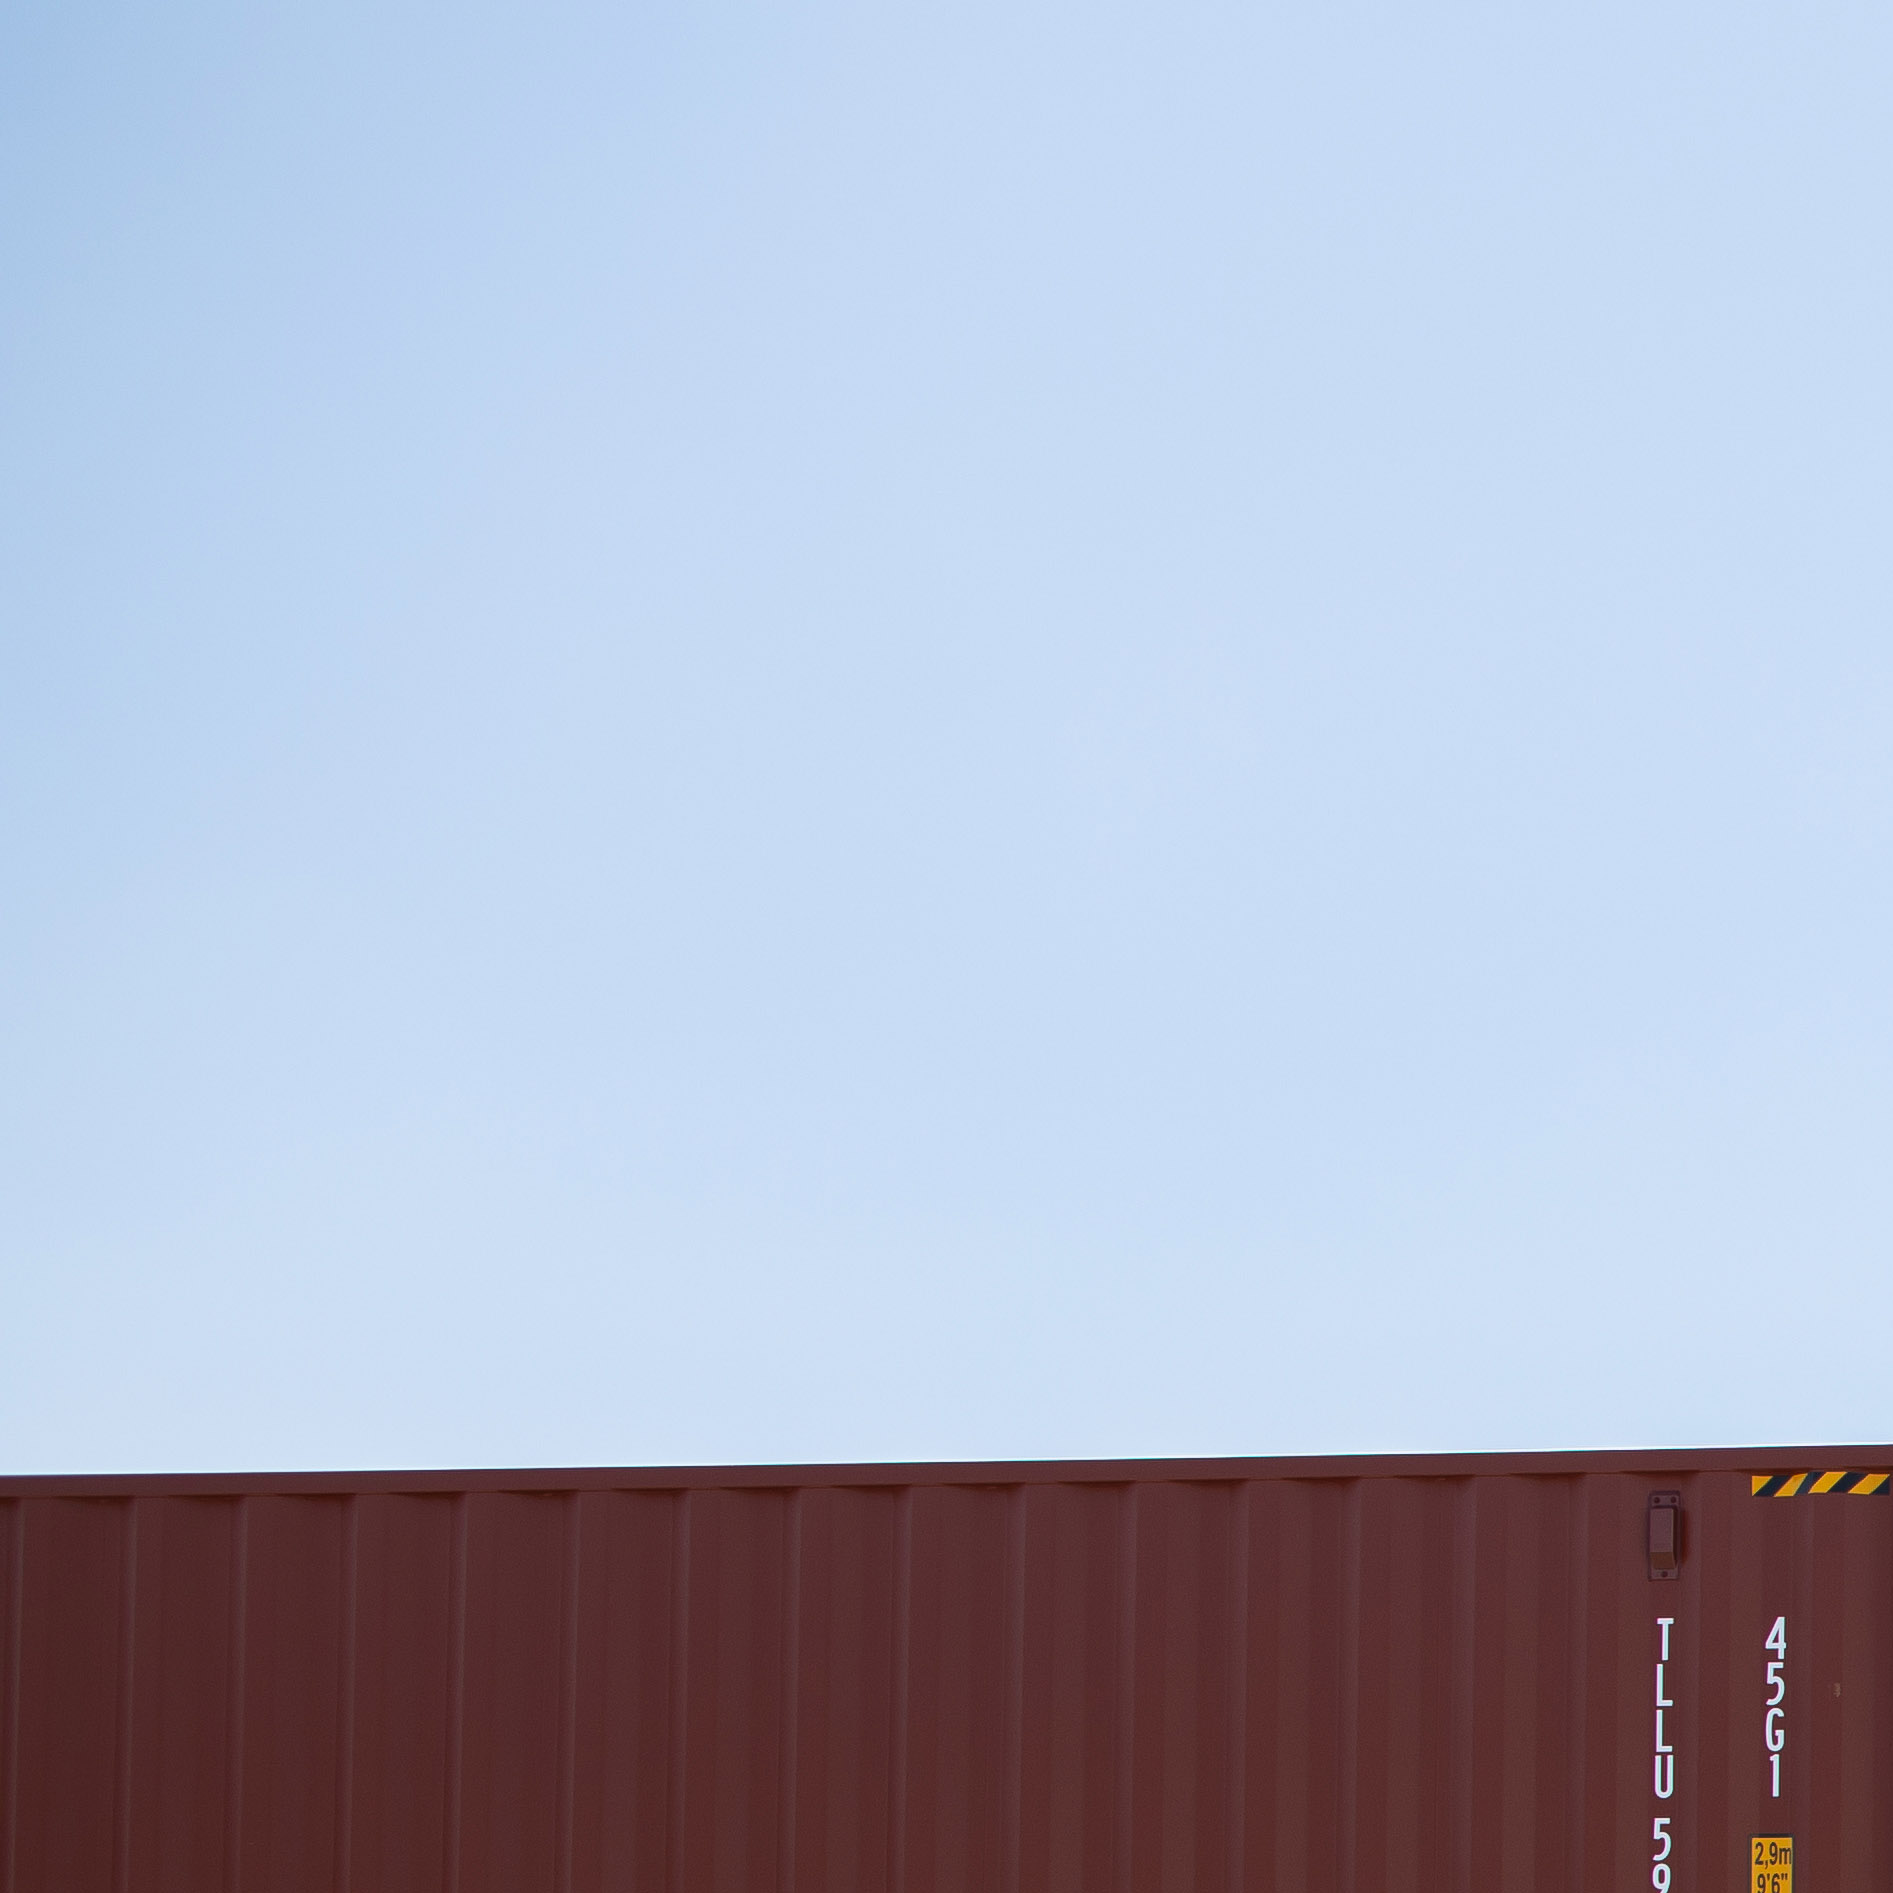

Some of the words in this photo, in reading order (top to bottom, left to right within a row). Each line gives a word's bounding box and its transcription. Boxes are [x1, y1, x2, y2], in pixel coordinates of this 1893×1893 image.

[1655, 1617, 1675, 1799] TLLU
[1765, 1616, 1787, 1798] 45G1
[1754, 1841, 1792, 1871] 2,9m
